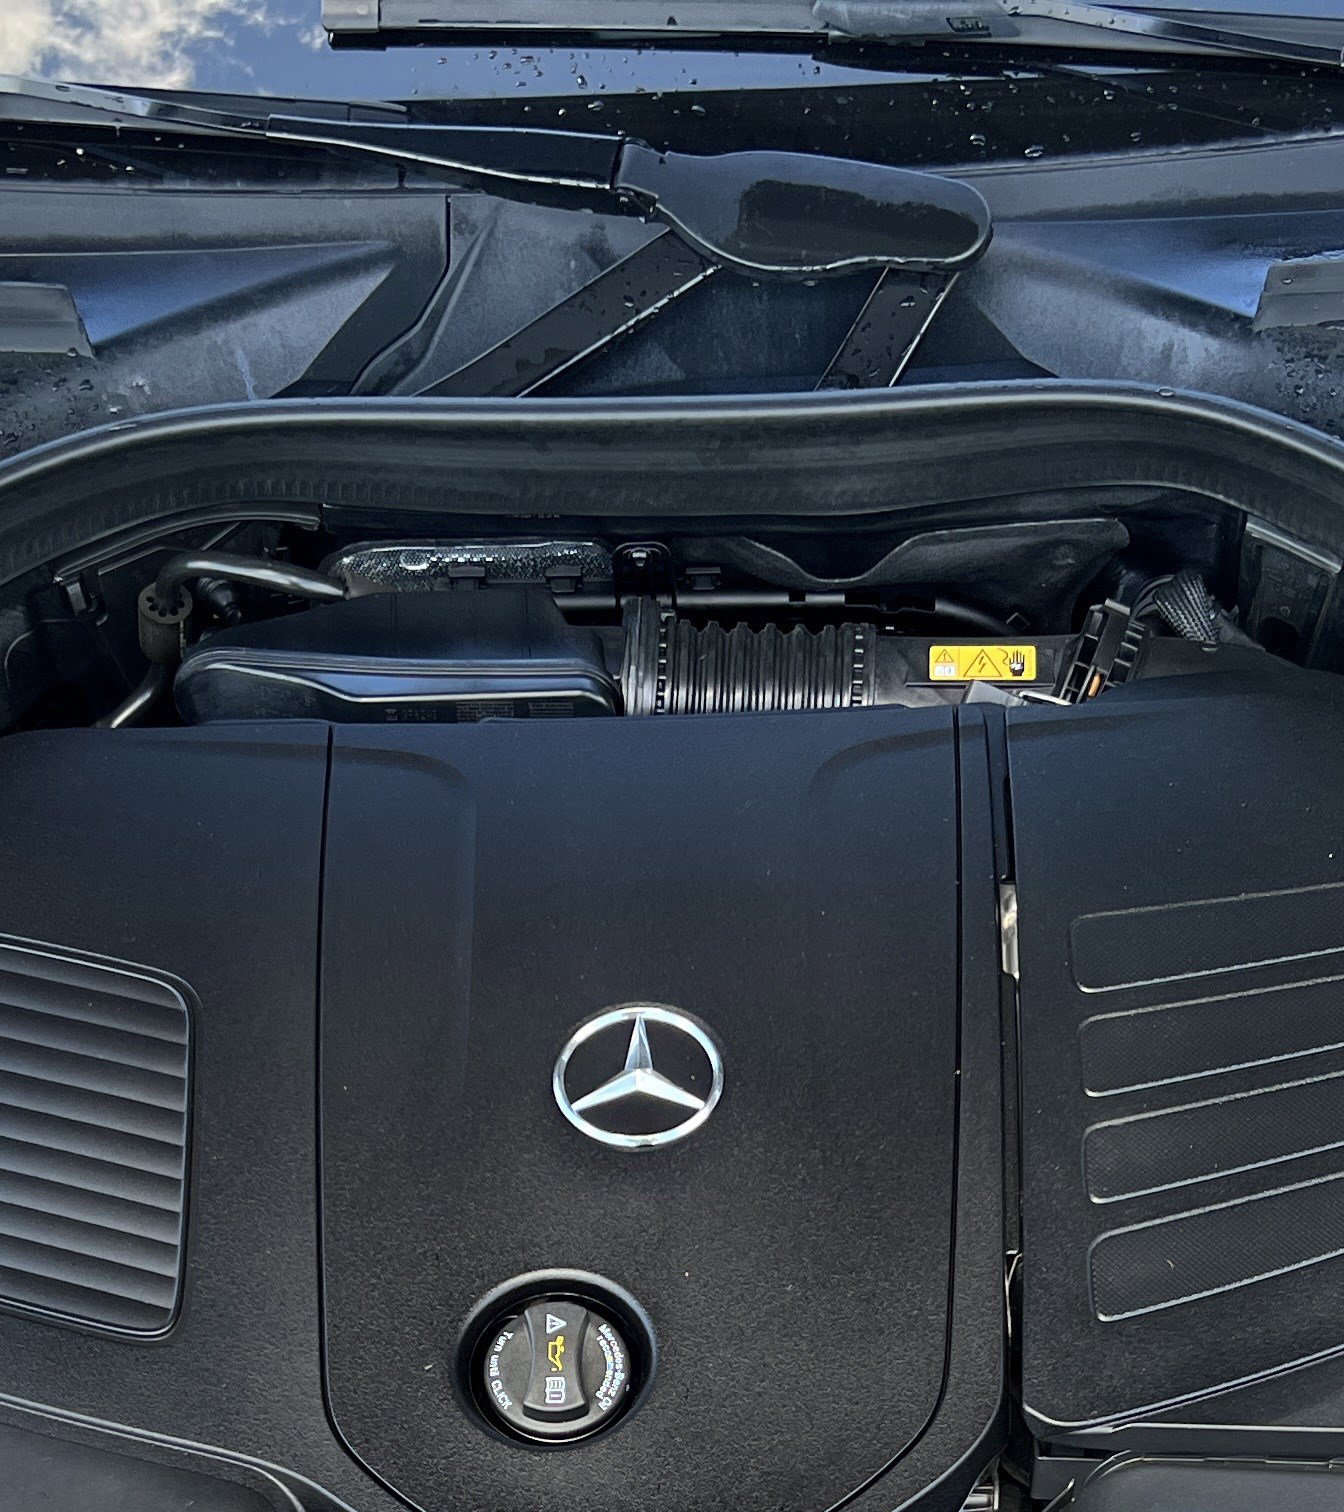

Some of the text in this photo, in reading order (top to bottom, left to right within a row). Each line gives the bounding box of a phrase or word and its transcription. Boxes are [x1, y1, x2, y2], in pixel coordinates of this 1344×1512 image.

[490, 1331, 514, 1410] Turn until CLICK
[595, 1335, 614, 1400] recommended
[597, 1323, 625, 1411] Mercedes-Benz Oil
